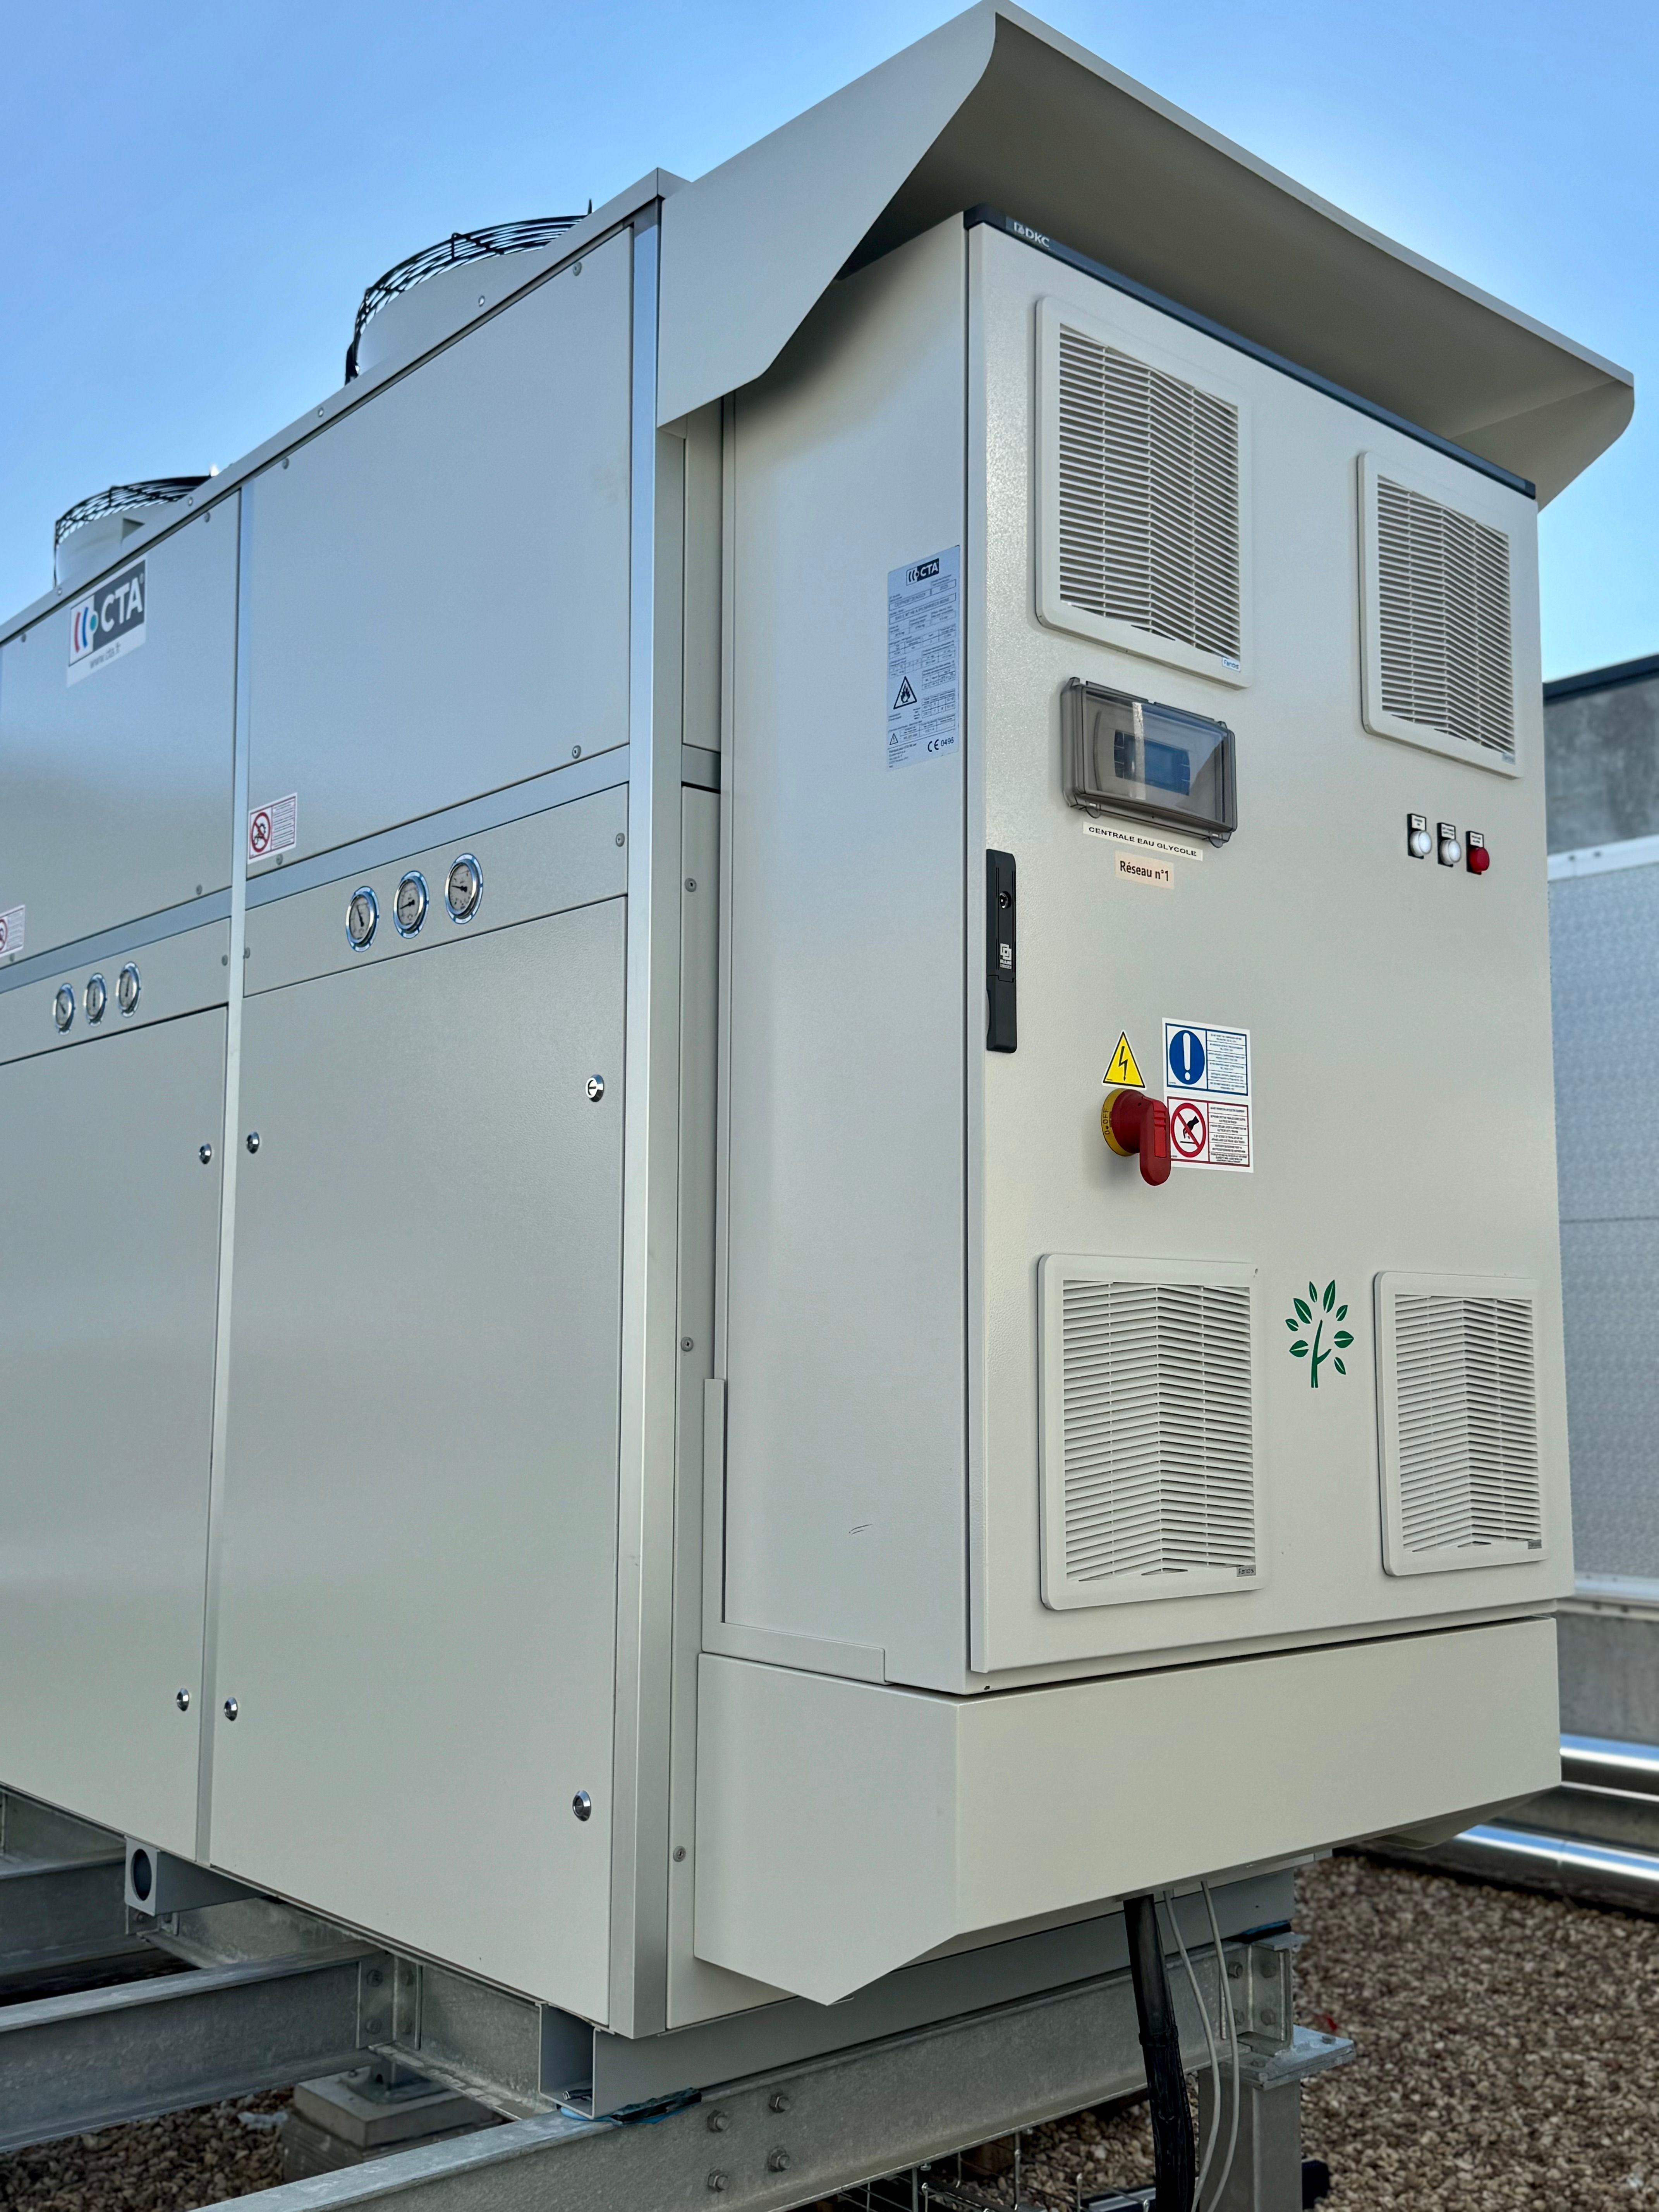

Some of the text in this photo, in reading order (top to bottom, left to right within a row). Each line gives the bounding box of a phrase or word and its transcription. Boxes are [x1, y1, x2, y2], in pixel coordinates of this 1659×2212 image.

[1025, 228, 1049, 247] DKC
[920, 562, 938, 577] CTA
[101, 577, 143, 632] CTA
[1089, 827, 1197, 857] CENTRALE EAU GLYCOLE
[1120, 860, 1169, 881] Réseau n°1
